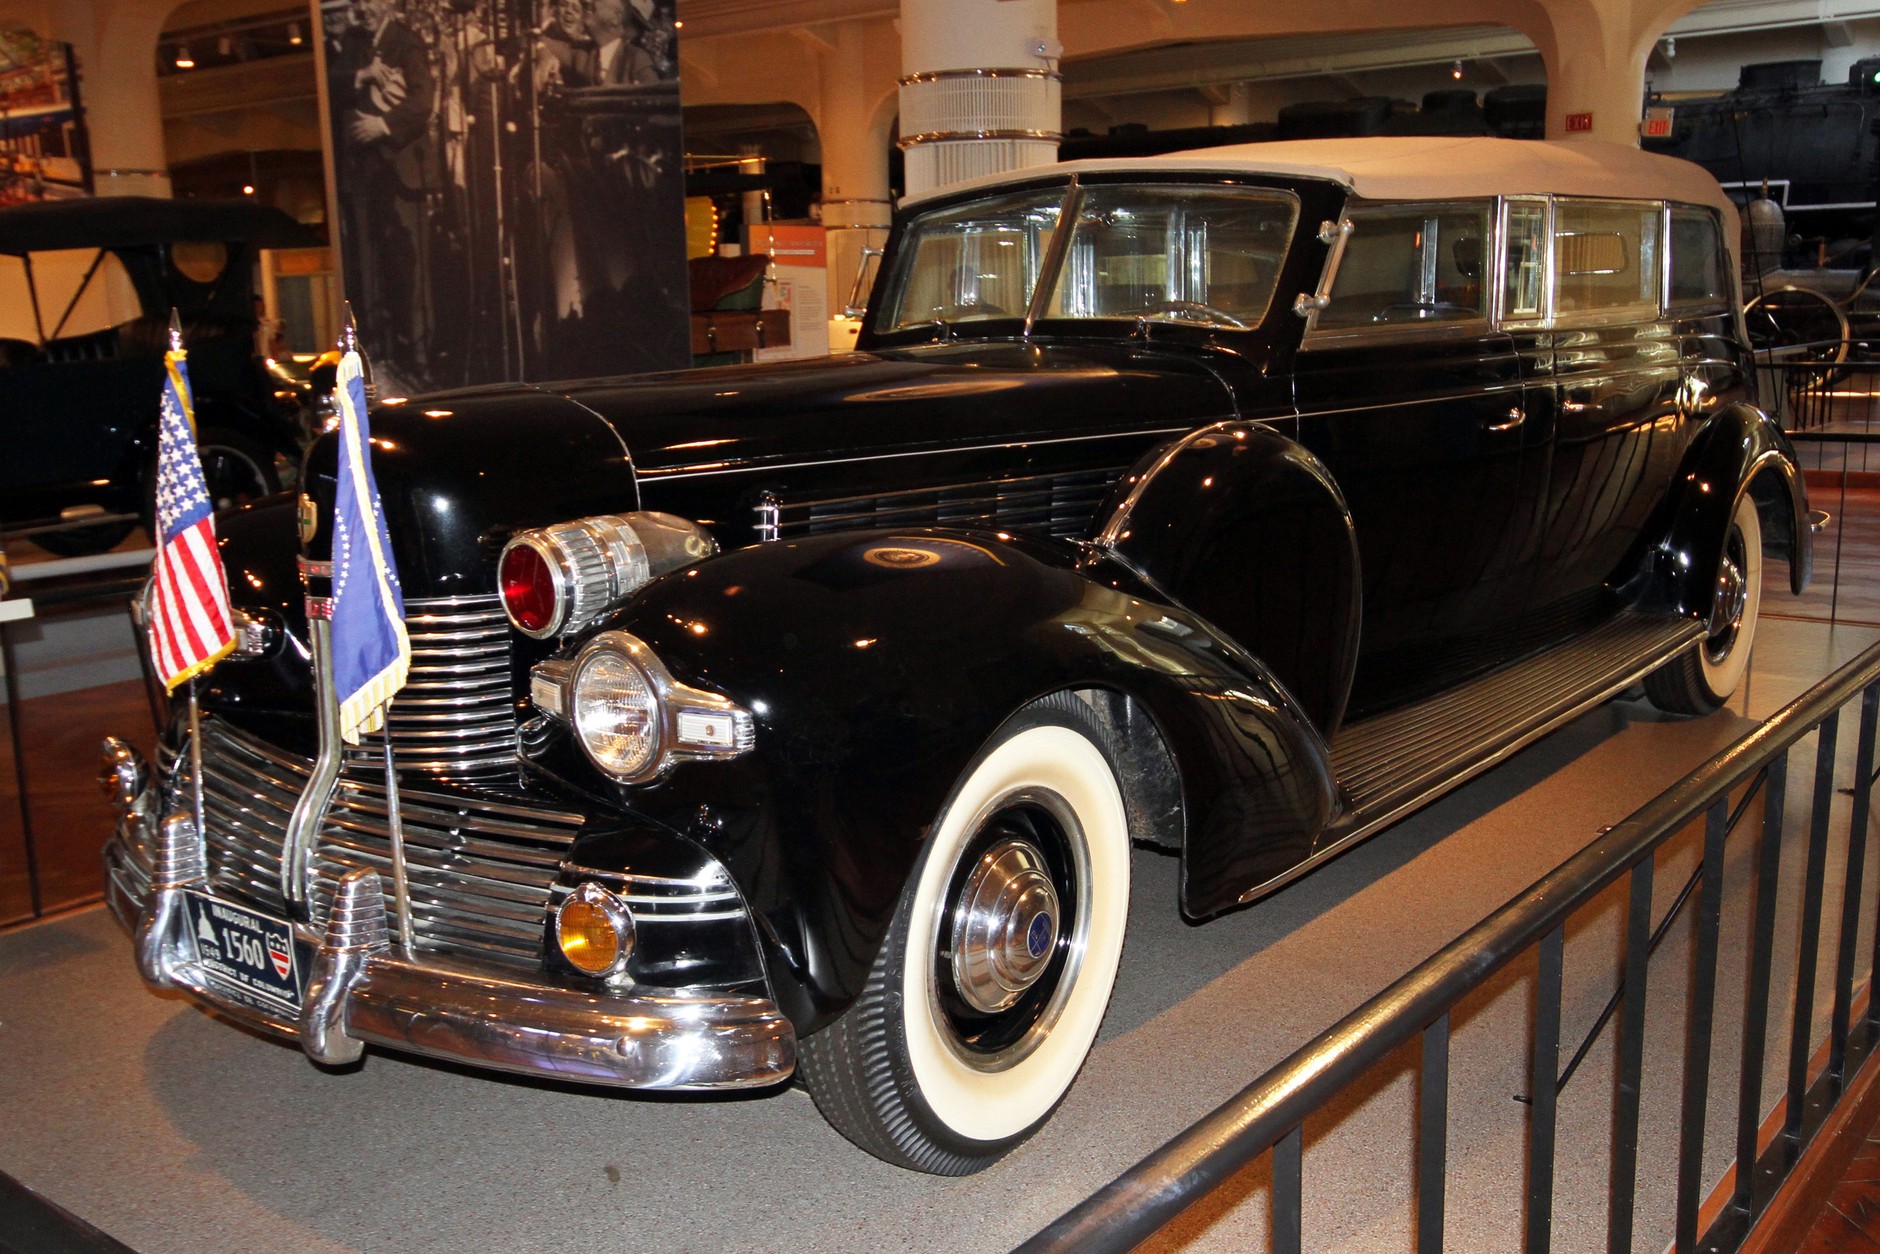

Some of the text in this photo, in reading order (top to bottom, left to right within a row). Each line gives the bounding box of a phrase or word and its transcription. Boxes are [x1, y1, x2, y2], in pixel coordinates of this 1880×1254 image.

[1568, 115, 1591, 129] EXIT
[1649, 120, 1668, 134] EXIT
[211, 903, 264, 934] INAUGURAL
[222, 927, 265, 970] 1560
